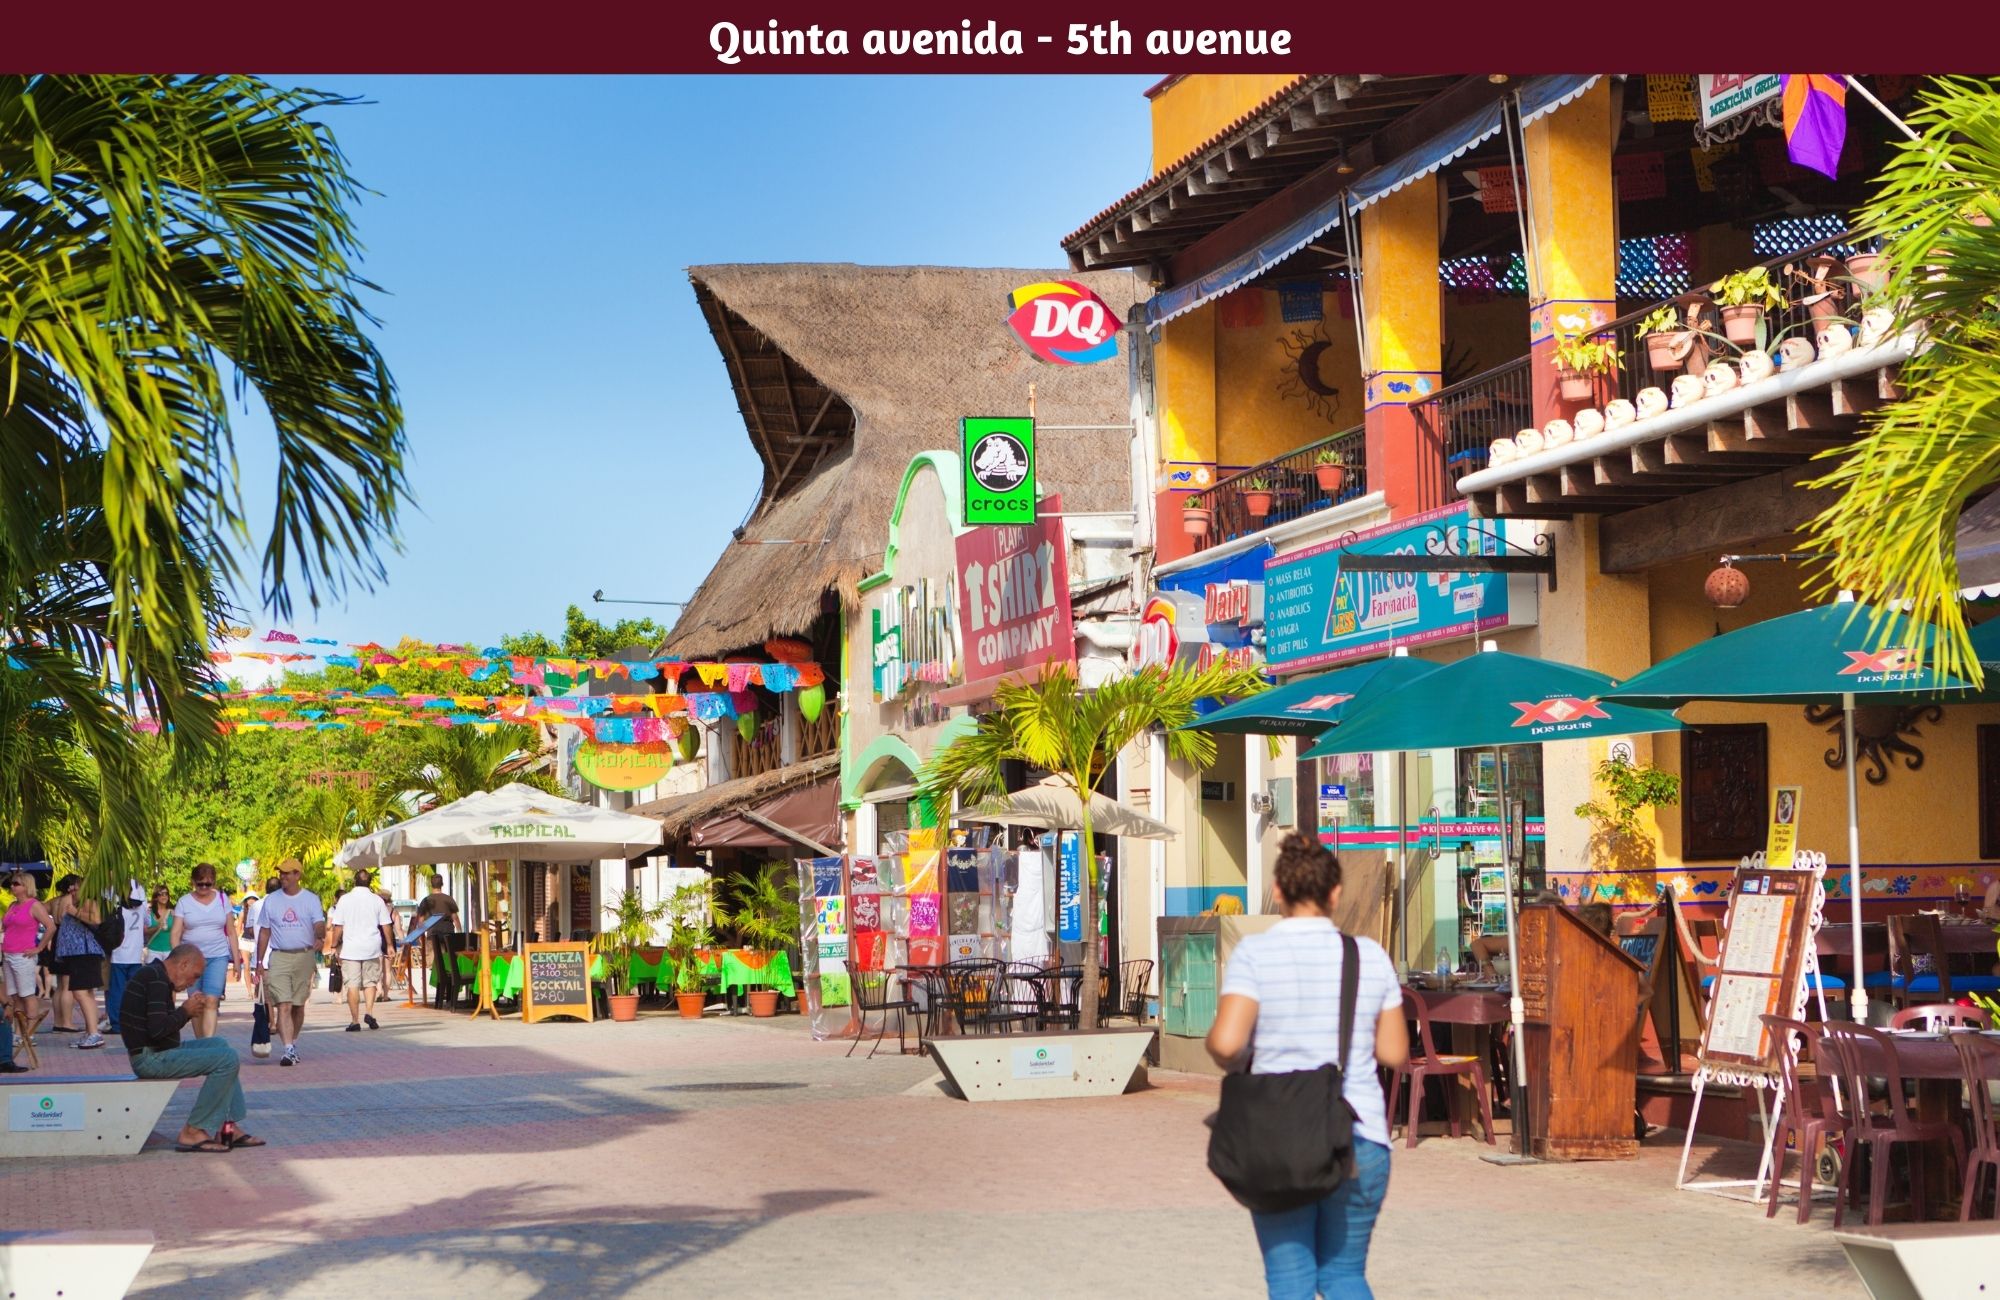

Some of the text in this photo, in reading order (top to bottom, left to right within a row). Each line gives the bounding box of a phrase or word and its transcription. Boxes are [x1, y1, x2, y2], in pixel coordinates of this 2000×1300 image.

[1709, 86, 1752, 117] MEXICAN
[972, 499, 1028, 511] crocs
[999, 527, 1025, 556] PLAYA
[1276, 566, 1312, 585] MASS RELAX
[1276, 583, 1313, 602] ANTIBIOTICS
[1205, 581, 1249, 627] Dairy
[1336, 592, 1349, 611] PAY
[1276, 602, 1311, 620] ANABOLICS
[1277, 622, 1299, 638] VIAGRA
[1332, 610, 1356, 636] LESS
[1277, 638, 1308, 654] DIET PILLS
[1857, 673, 1883, 683] DOS
[1531, 721, 1592, 735] DOS EQUIS
[582, 751, 671, 769] TROPICAL
[489, 823, 576, 839] TROPICAL
[1463, 823, 1486, 833] ALEVE
[1060, 853, 1071, 930] infinitum
[129, 911, 140, 930] 2
[531, 952, 582, 963] CERVEZA
[831, 945, 847, 954] AVE
[563, 969, 580, 977] SOL
[532, 981, 585, 991] COCKTAIL
